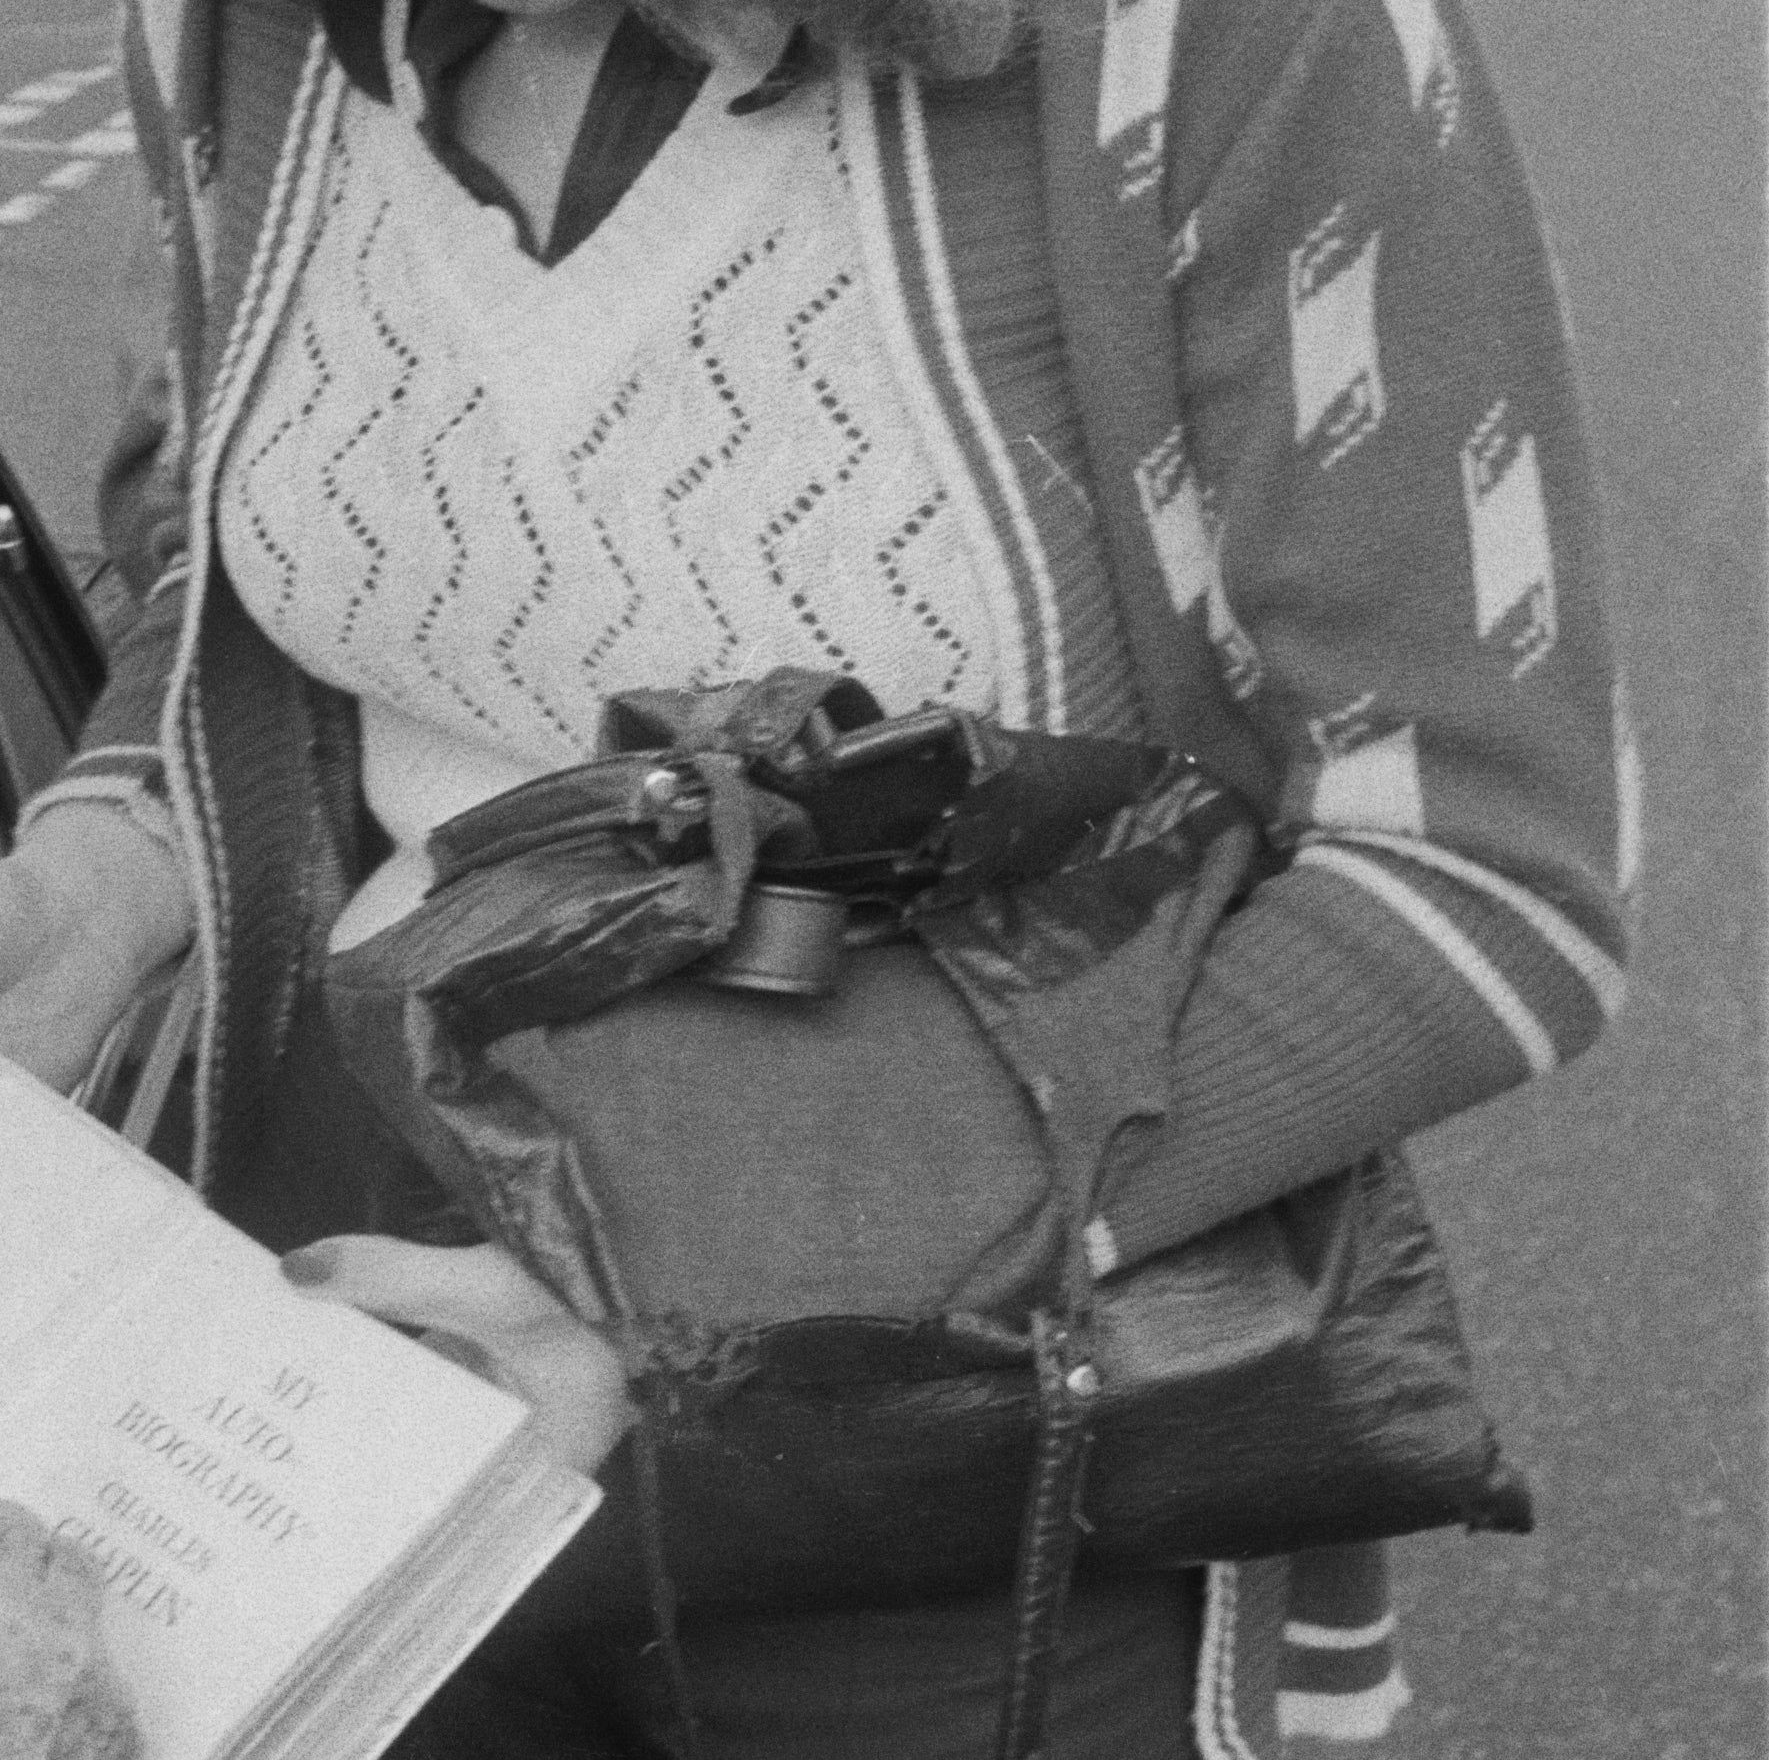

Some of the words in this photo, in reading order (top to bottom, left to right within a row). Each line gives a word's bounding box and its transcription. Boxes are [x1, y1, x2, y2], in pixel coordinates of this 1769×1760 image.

[264, 1364, 322, 1412] MY
[112, 1399, 306, 1542] BIOGRAPHY
[96, 1481, 214, 1575] CHARLES
